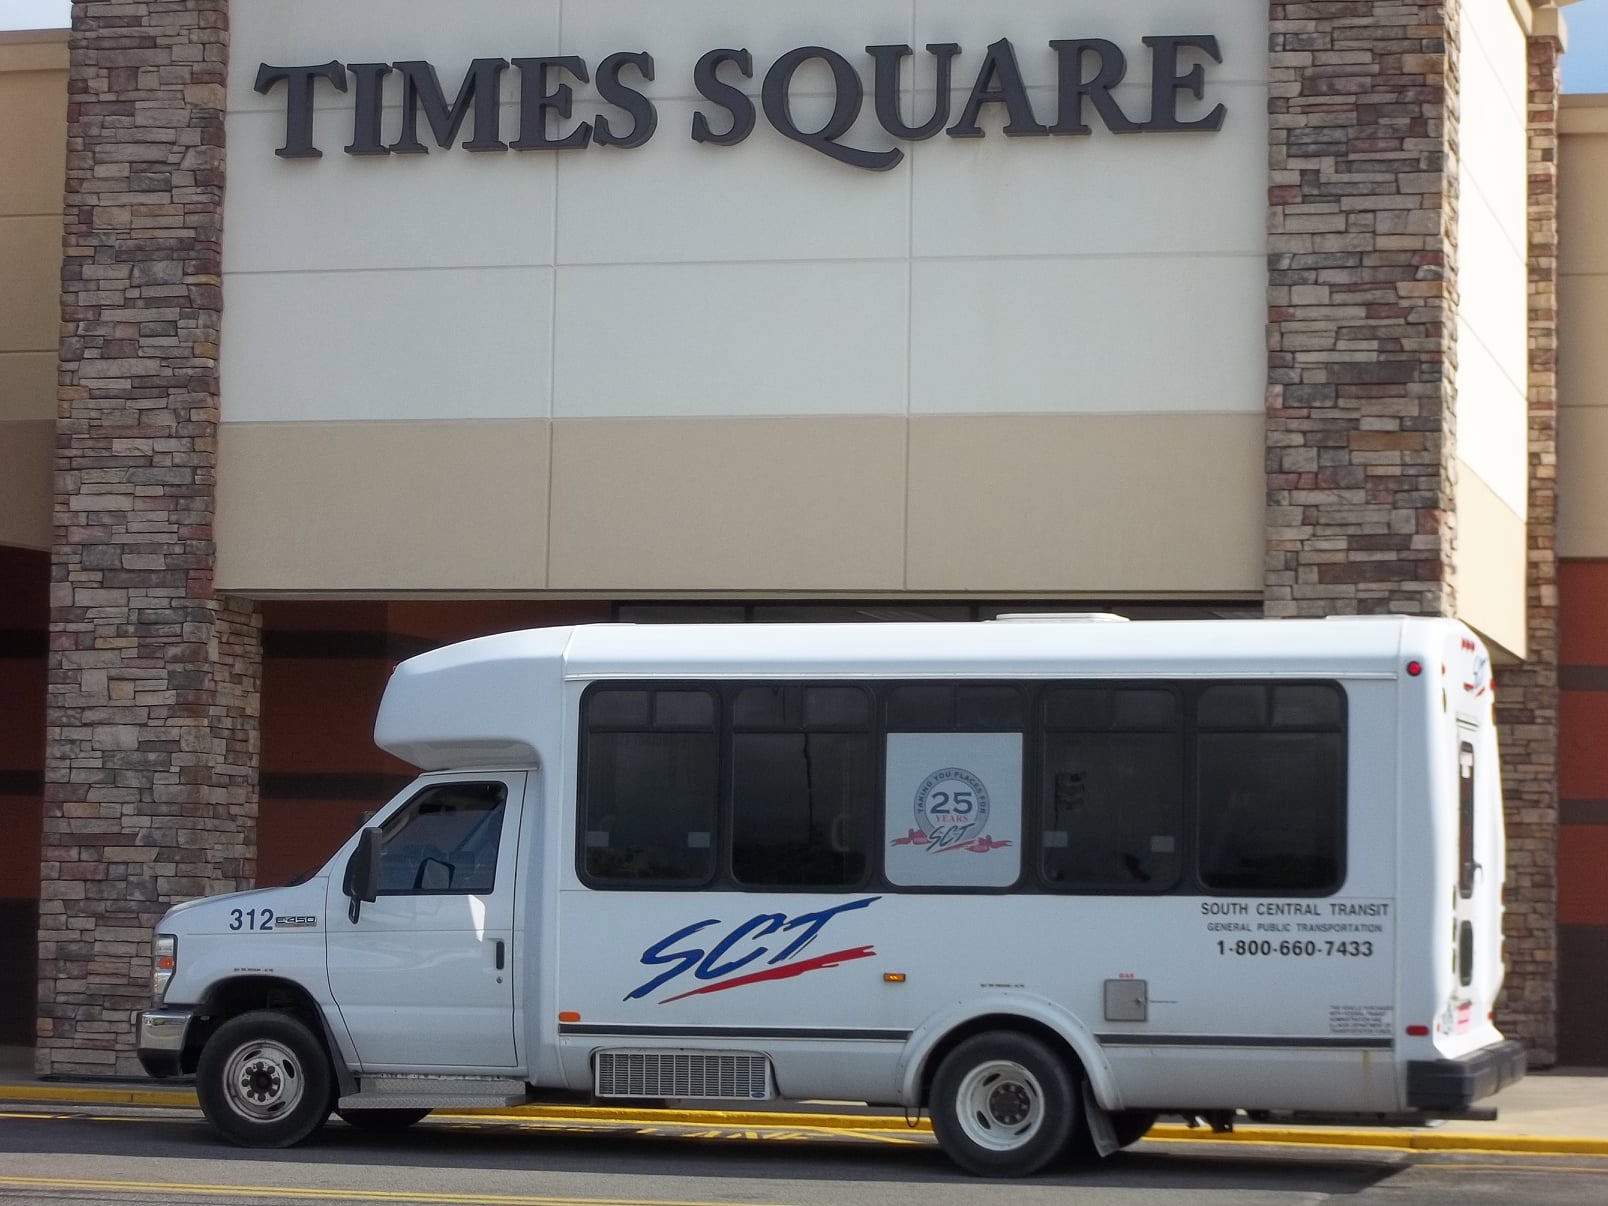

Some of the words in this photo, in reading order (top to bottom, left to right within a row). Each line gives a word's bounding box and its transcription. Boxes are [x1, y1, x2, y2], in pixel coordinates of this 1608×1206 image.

[253, 51, 657, 158] TIMES
[692, 34, 1227, 171] SQUARE
[917, 780, 933, 813] TAKING
[933, 771, 951, 782] YOU
[954, 771, 984, 794] PLACES
[979, 795, 987, 814] FOR
[930, 791, 973, 814] 25
[935, 815, 969, 823] YEARS
[926, 823, 976, 851] SCT
[229, 908, 274, 931] 312
[1200, 902, 1249, 916] SOUTH
[1256, 902, 1321, 916] CENTRAL
[1330, 903, 1390, 917] TRANSIT
[1207, 922, 1252, 932] GENERAL
[1257, 923, 1291, 933] PUBLIC
[1296, 923, 1384, 933] TRANSPORTATION
[622, 896, 883, 1001] SCT
[1216, 940, 1374, 957] 1-800-660-7433
